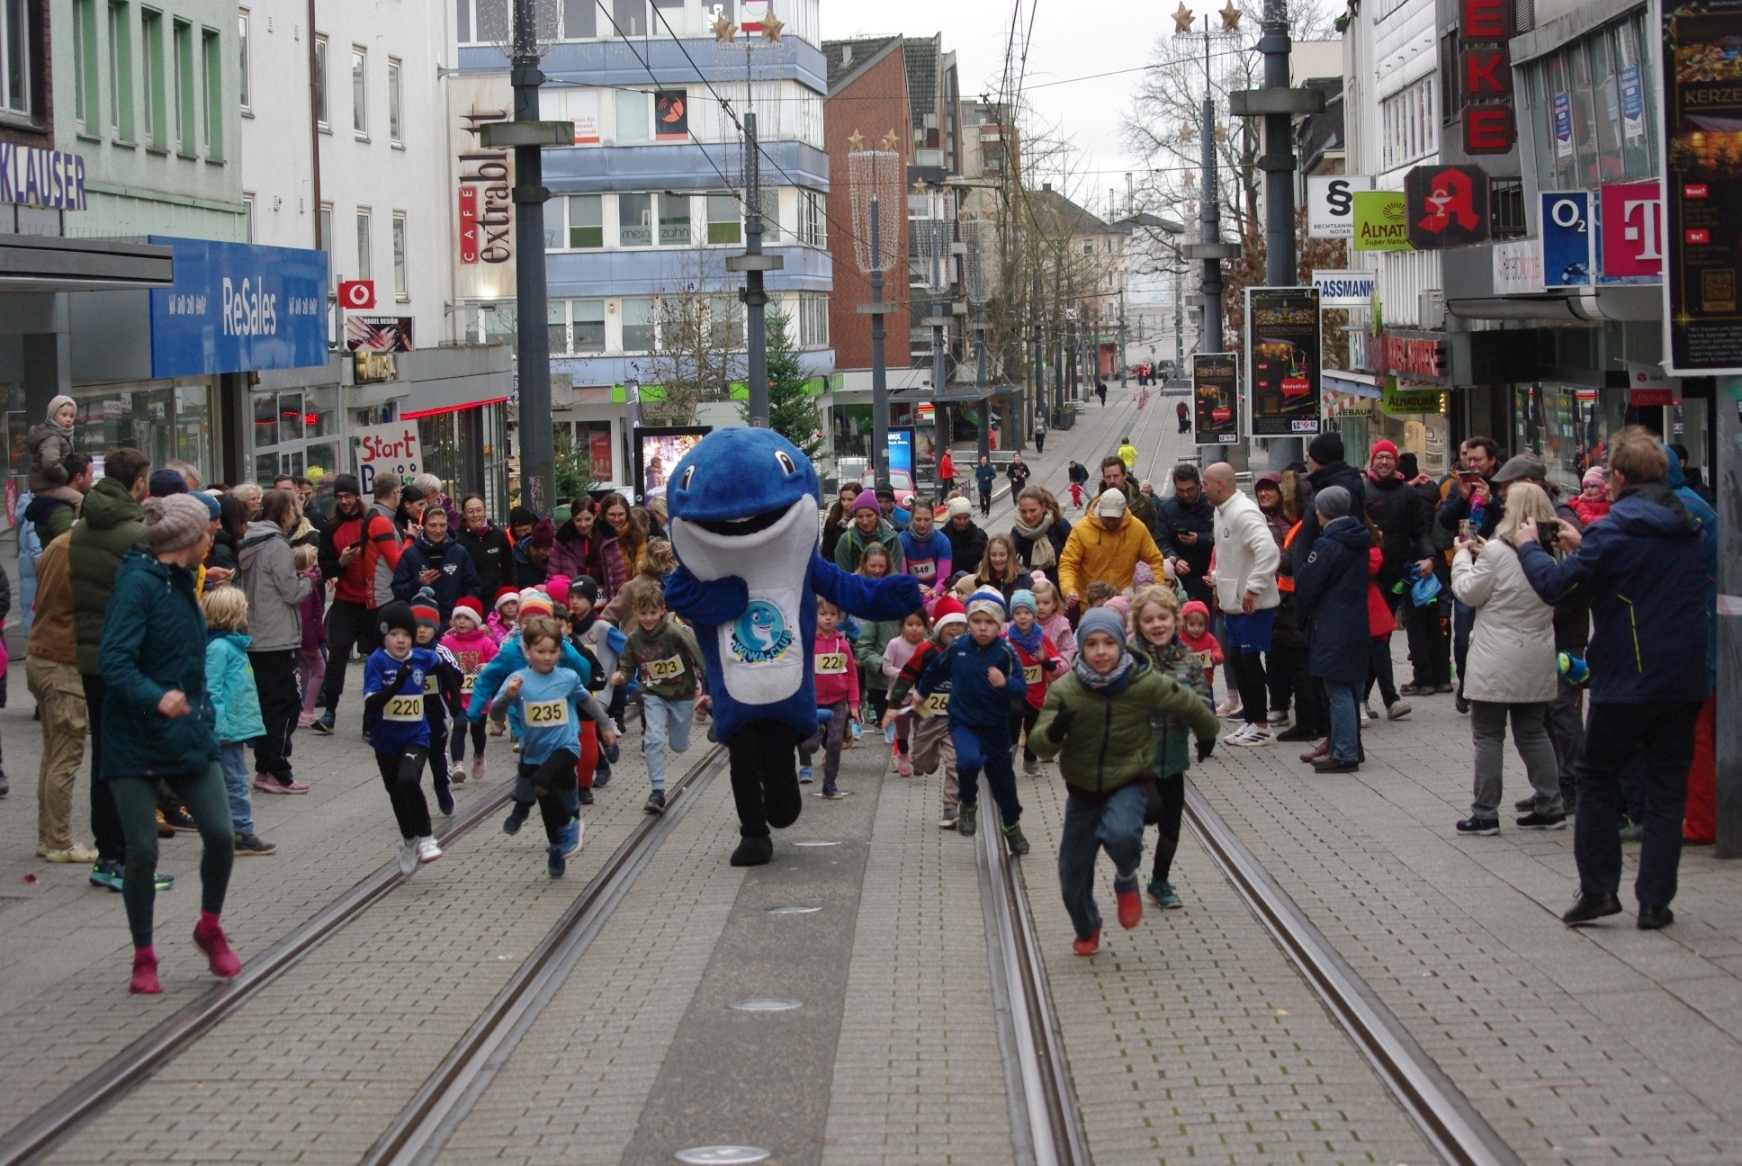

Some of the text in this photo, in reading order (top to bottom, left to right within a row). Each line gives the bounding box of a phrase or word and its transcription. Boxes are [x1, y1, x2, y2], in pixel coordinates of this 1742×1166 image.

[0, 142, 87, 211] KLAUSER
[622, 225, 690, 239] mein zahn
[222, 276, 277, 336] ReSales
[1388, 395, 1437, 407] ALNATURA
[362, 430, 416, 462] Start
[914, 565, 929, 574] 549
[734, 630, 793, 662] WIWA-CLUB
[392, 700, 420, 716] 220
[532, 703, 562, 723] 235
